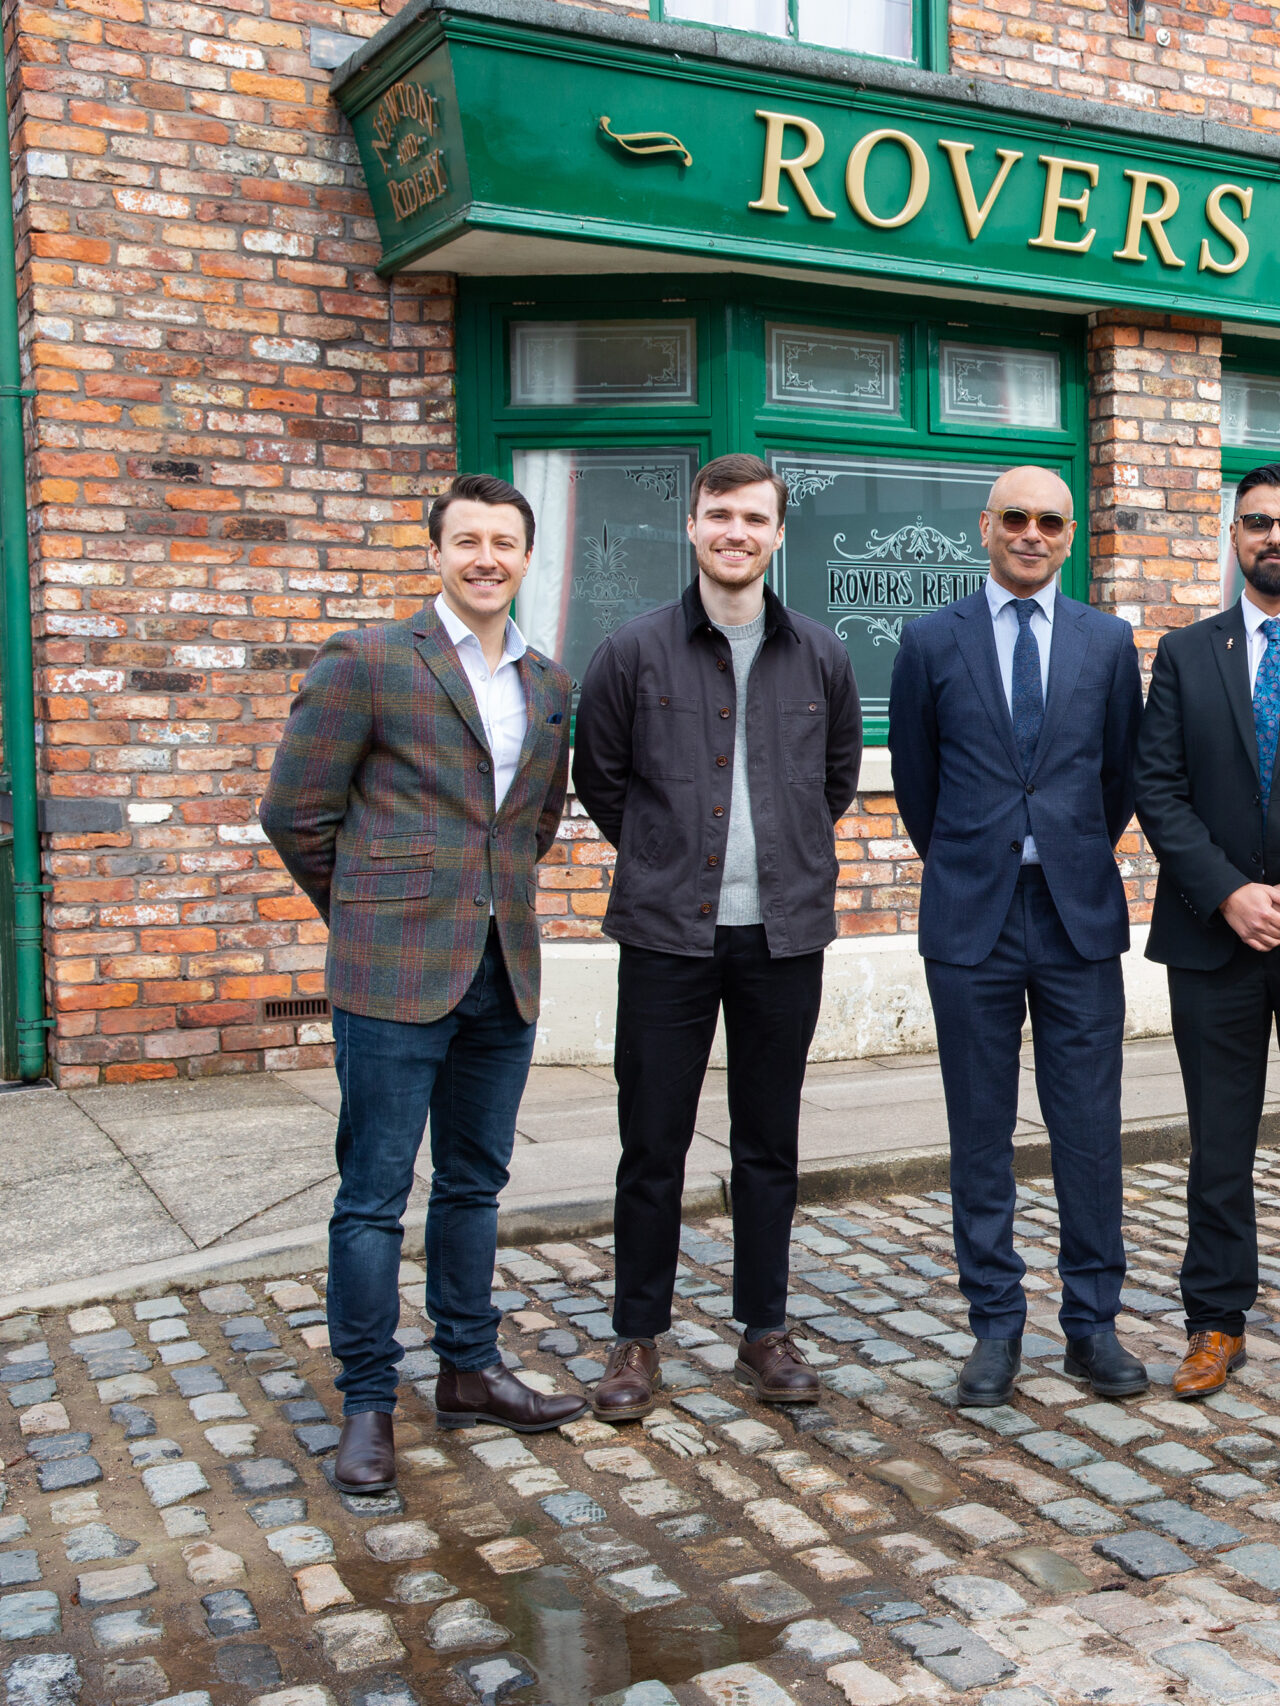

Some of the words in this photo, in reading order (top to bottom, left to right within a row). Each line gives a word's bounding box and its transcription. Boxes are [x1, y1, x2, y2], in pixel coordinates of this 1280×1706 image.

[372, 82, 434, 176] NEWTON
[398, 133, 419, 166] AND
[387, 148, 445, 222] RIDLEY
[748, 108, 1254, 275] ROVERS
[828, 568, 914, 607] ROVERS
[921, 571, 987, 607] RETU
